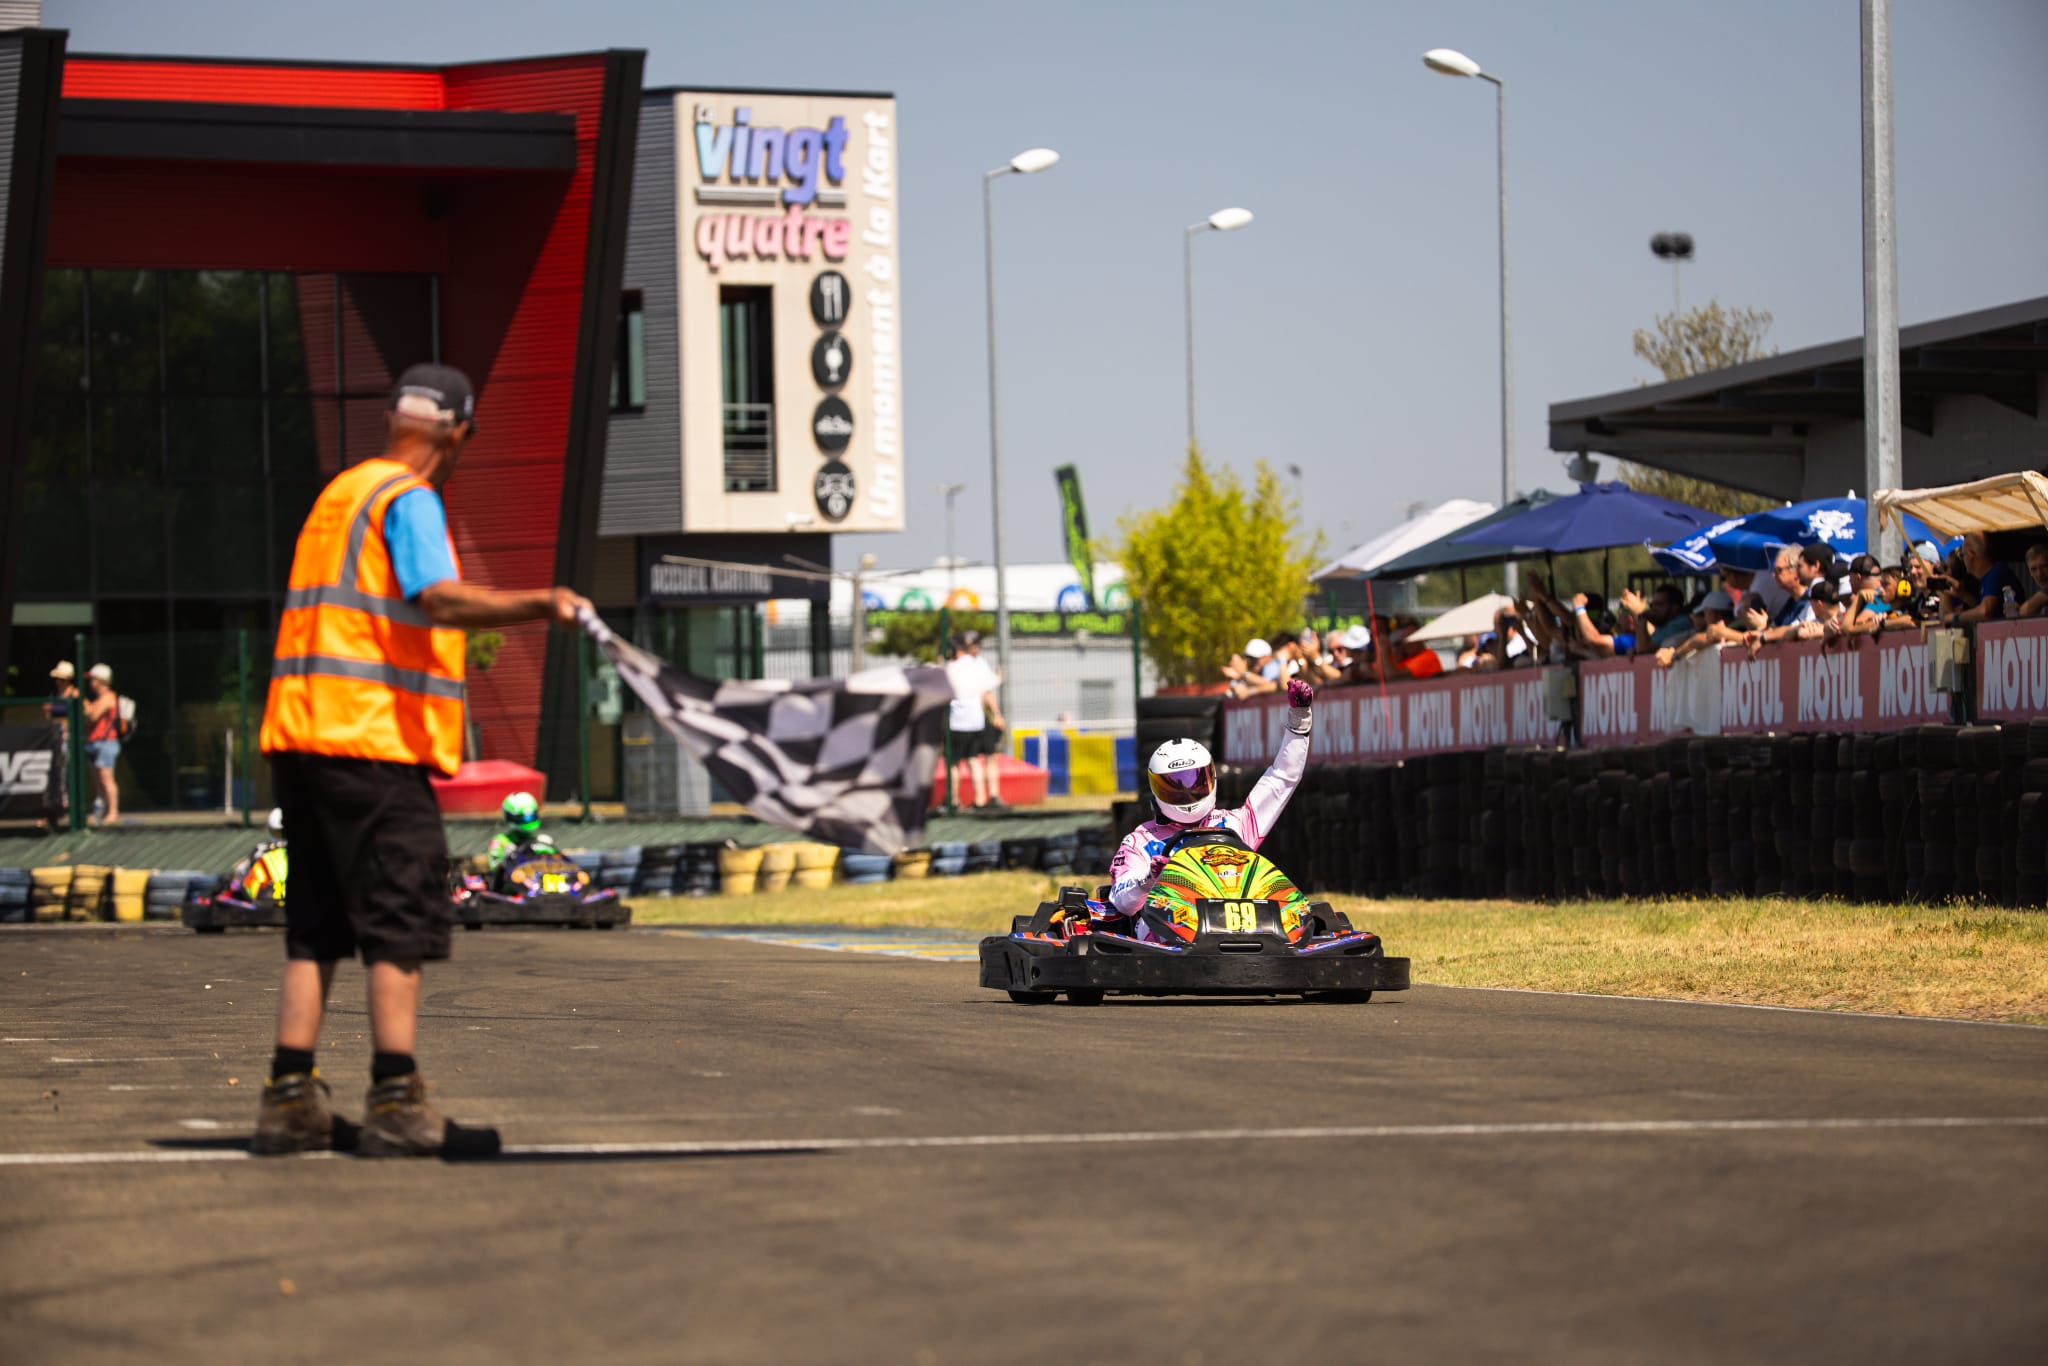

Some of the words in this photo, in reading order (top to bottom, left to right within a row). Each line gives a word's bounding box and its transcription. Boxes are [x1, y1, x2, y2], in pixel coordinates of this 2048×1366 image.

[694, 107, 849, 205] vingt
[861, 111, 891, 199] Kart
[695, 203, 850, 269] quatre
[861, 206, 892, 246] la
[866, 288, 896, 457] moment
[868, 462, 897, 519] Un
[1408, 690, 1454, 750] MOTUL
[1459, 685, 1507, 745] MOTUL
[1583, 671, 1637, 736] MOTUL
[1722, 658, 1784, 727] MOTUL
[1798, 651, 1863, 722] MOTUL
[1224, 902, 1257, 931] 69
